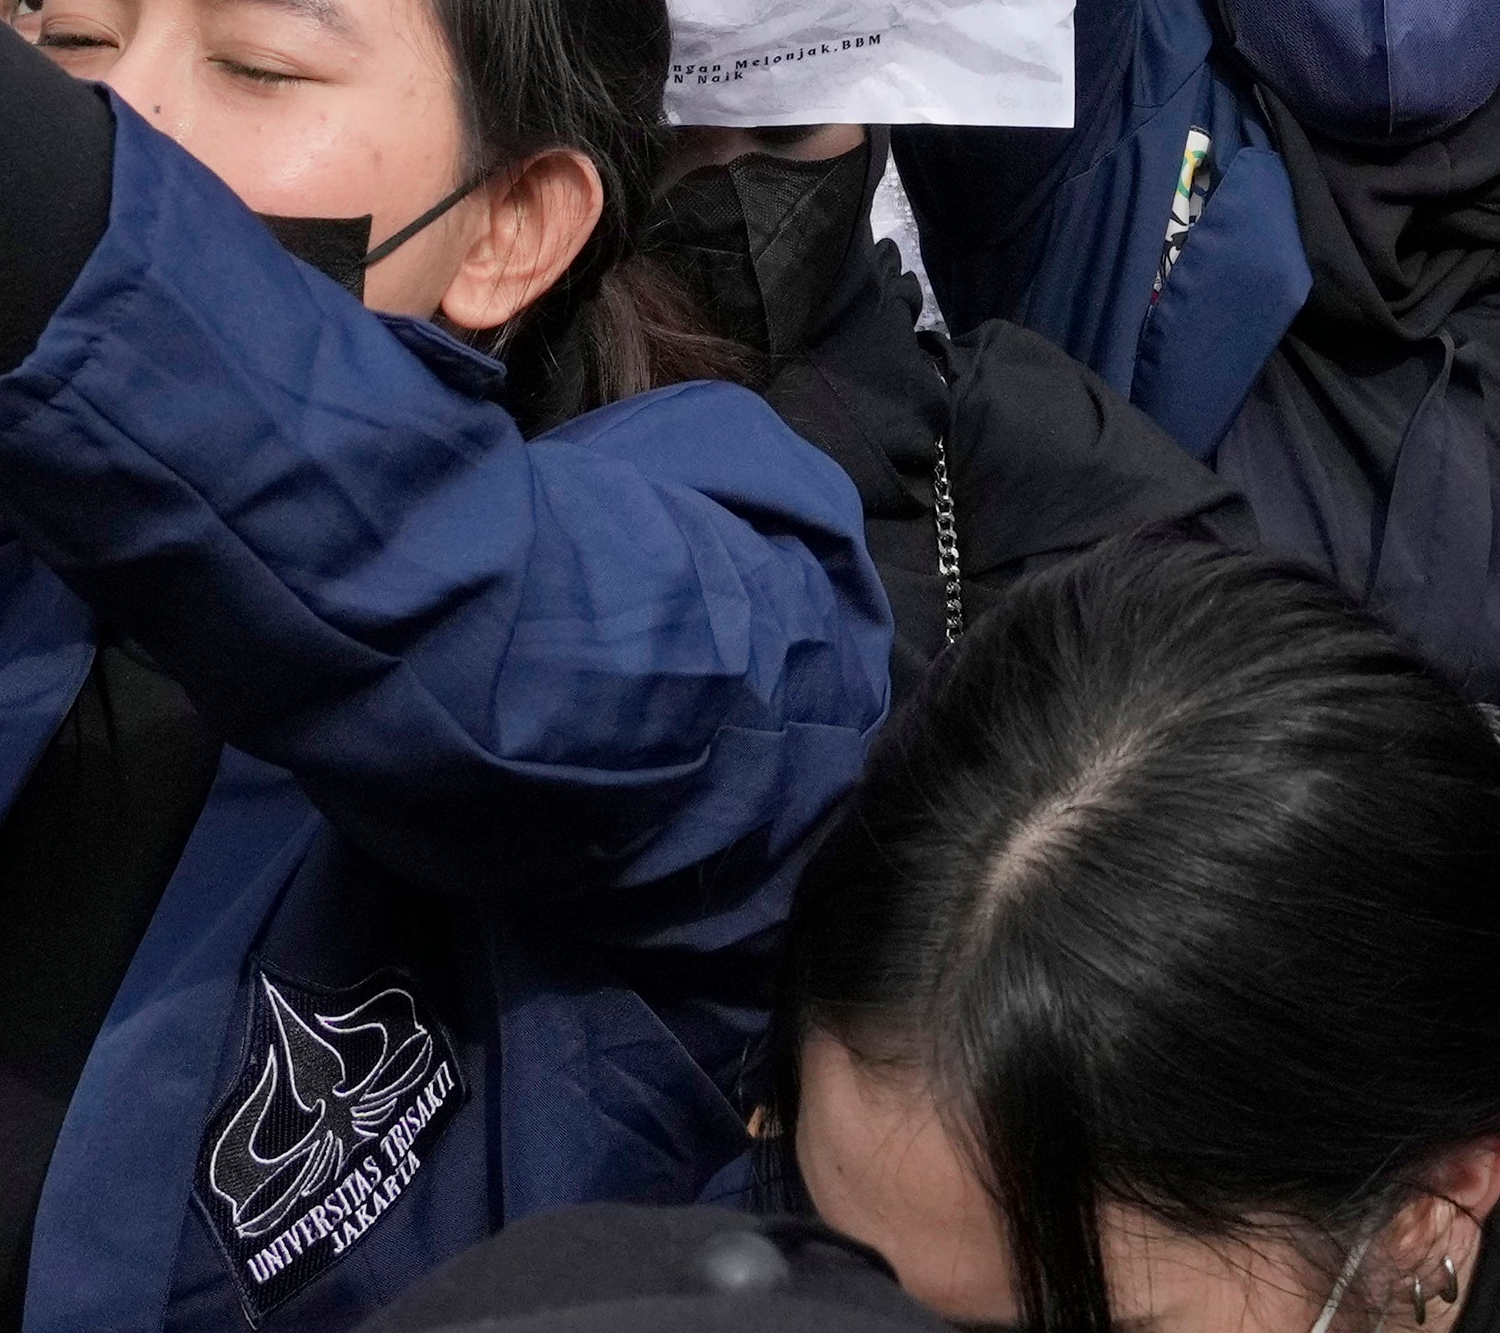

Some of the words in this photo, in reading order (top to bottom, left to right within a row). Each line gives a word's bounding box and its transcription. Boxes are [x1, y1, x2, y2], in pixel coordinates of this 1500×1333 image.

[672, 62, 721, 76] ngan
[735, 34, 881, 70] Melonjak.BBM
[698, 71, 743, 84] Naik
[248, 1154, 383, 1284] UNIVERSITAS
[380, 1061, 456, 1167] TRISAKTI
[332, 1151, 421, 1254] JAKARTA
